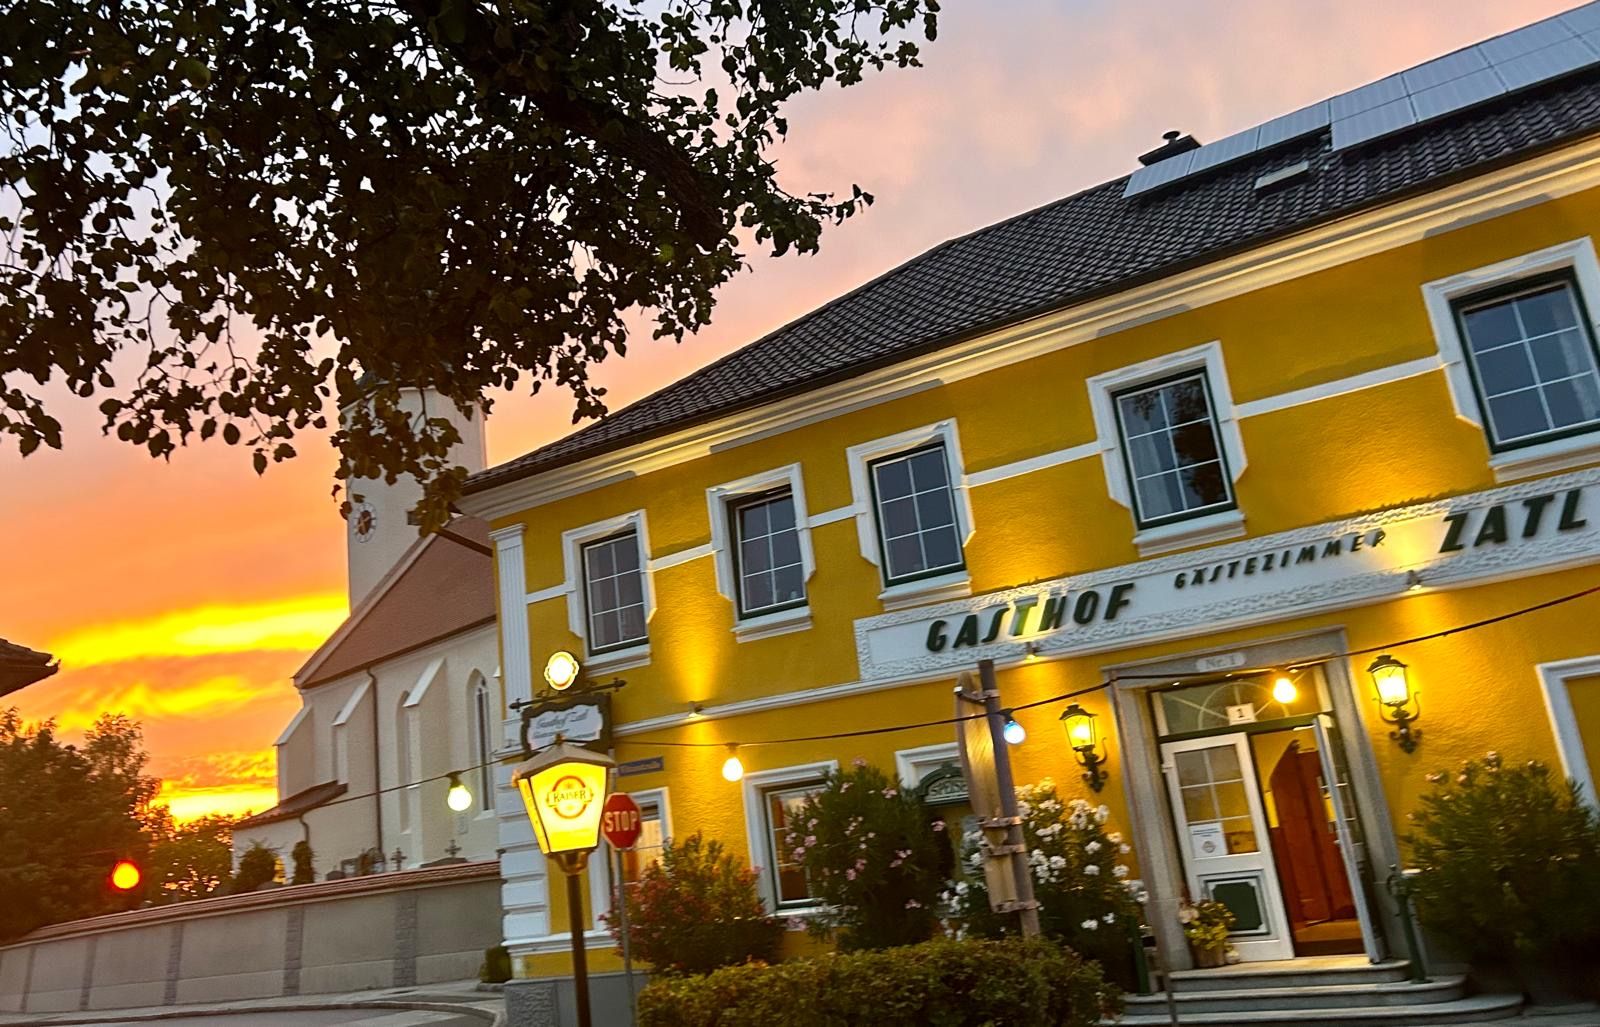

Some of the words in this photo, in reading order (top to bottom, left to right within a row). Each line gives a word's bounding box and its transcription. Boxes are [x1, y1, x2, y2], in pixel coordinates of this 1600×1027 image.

[925, 582, 1135, 653] GASTHOF
[1174, 529, 1386, 589] GÄSTEZIMMER
[1439, 489, 1588, 554] ZATL
[1236, 708, 1245, 719] 1
[553, 790, 586, 803] KAISER
[604, 810, 638, 833] STOP
